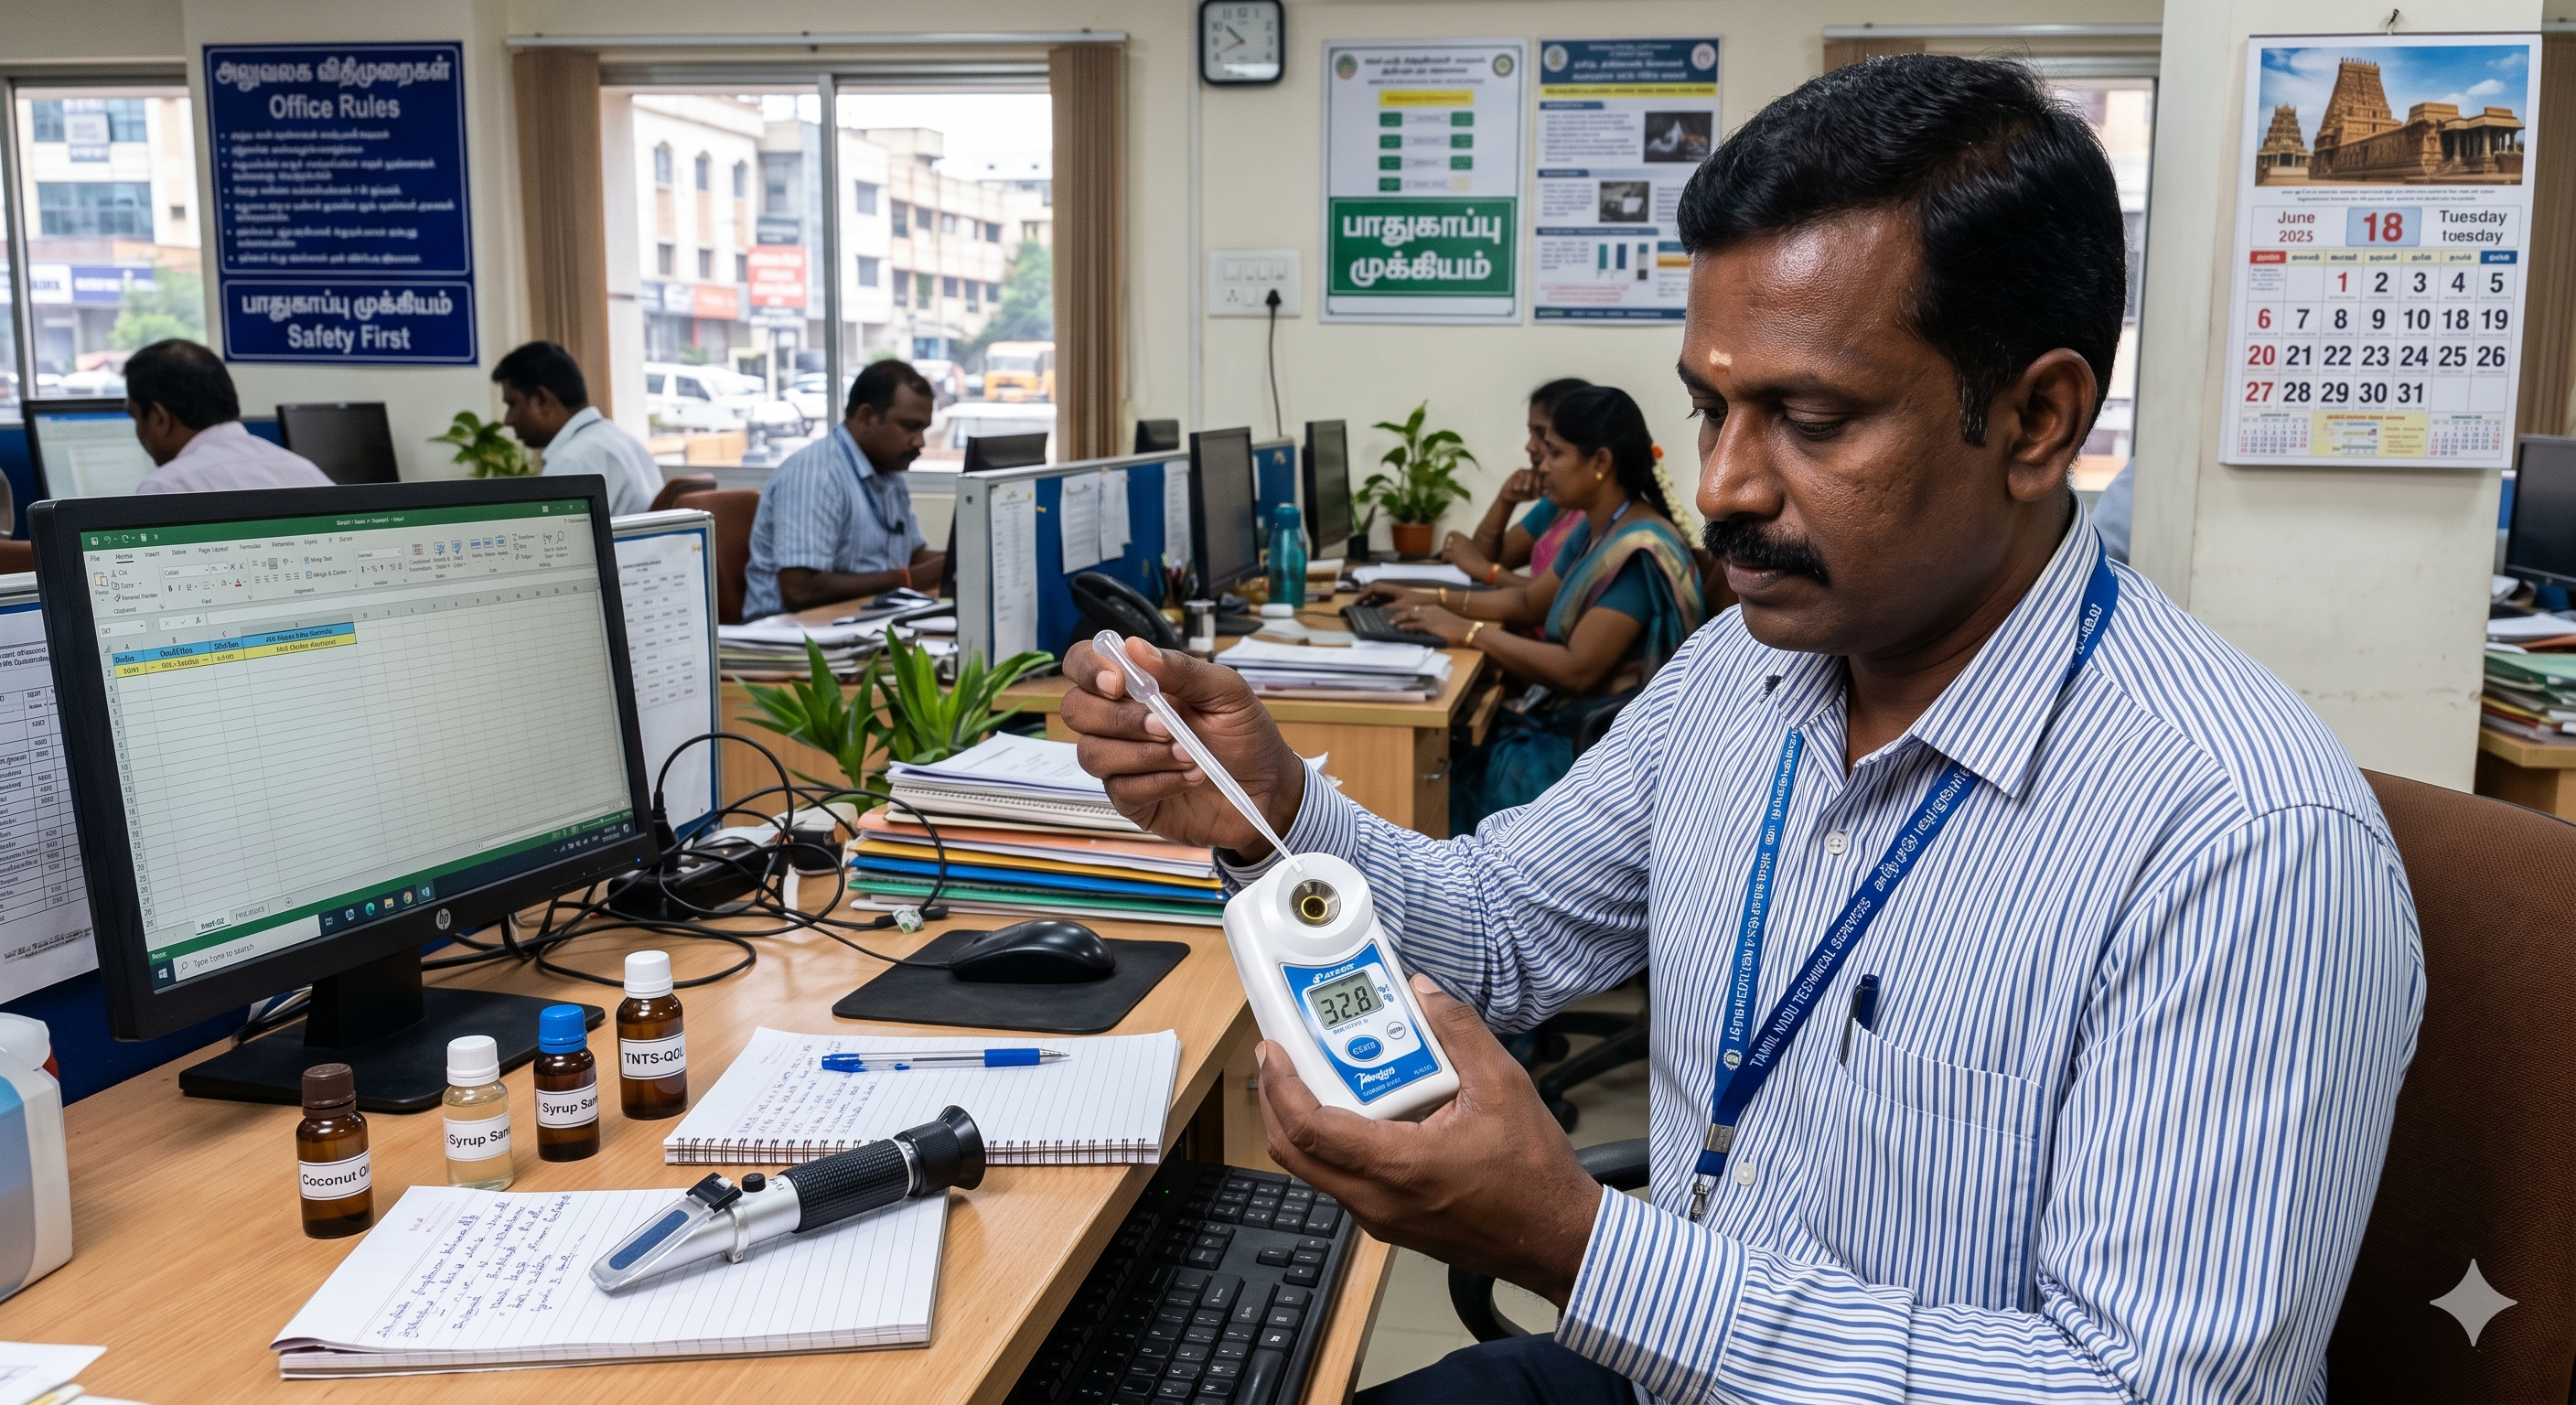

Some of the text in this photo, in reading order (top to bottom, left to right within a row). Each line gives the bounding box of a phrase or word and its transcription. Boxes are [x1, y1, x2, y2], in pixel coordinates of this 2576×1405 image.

[269, 94, 401, 120] Office Rules
[1343, 207, 1501, 247] பாதுகாப்பு
[2278, 211, 2315, 225] June
[2363, 212, 2404, 242] 18
[2439, 209, 2507, 226] Tuesday
[1349, 250, 1492, 287] முக்கியம்
[2337, 272, 2505, 294] 1 2 3 4 5
[242, 289, 454, 323] பாதுகாப்பு முக்கியம்
[2257, 308, 2508, 329] 6 7 8 9 10 18 19
[287, 324, 411, 355] Safety First
[2248, 345, 2506, 367] 20 21 22 23 24 25 26
[2245, 381, 2424, 403] 27 28 29 30 31
[1320, 985, 1372, 1025] 32.8
[1773, 1003, 1799, 1035] NADU
[542, 1103, 577, 1116] Syrup
[449, 1134, 486, 1148] Syrup
[303, 1171, 357, 1186] Coconut
